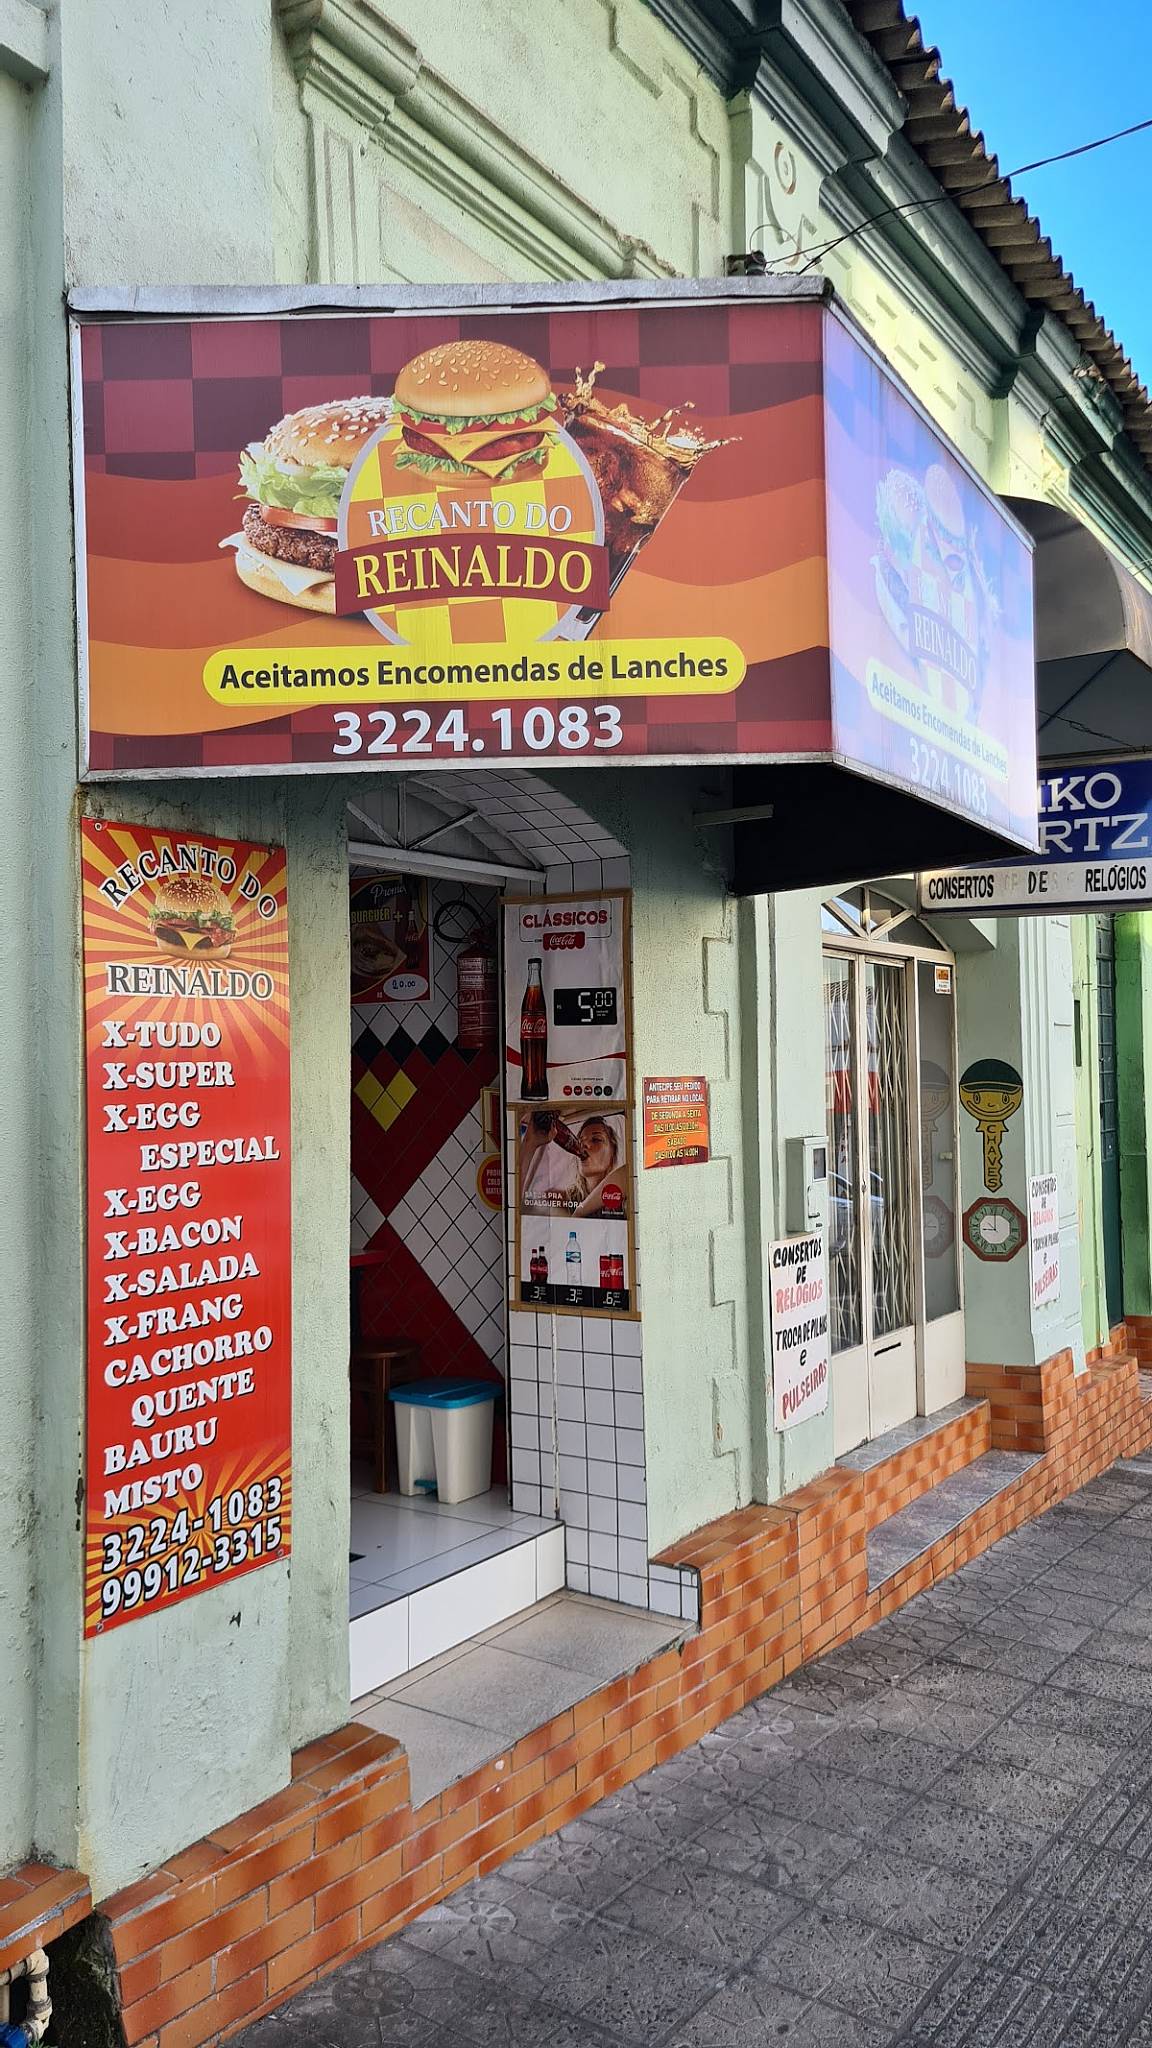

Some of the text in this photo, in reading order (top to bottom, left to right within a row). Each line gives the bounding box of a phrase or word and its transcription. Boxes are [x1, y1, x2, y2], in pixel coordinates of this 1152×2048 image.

[367, 499, 572, 537] RECANTO DO
[353, 545, 592, 598] REINALDO
[219, 653, 728, 690] Aceitamos Encomendas de Lanches
[913, 611, 977, 690] REINALDO
[332, 705, 624, 756] 3224.1083
[872, 672, 921, 721] Aceitamos
[922, 705, 972, 753] Encomendas
[910, 737, 988, 816] 3224.1083
[1038, 813, 1148, 855] RTZ
[99, 842, 278, 921] RECANTO DO
[928, 875, 994, 900] CONSERTOS
[1028, 871, 1048, 894] DE
[1085, 864, 1147, 892] RELÓGIOS
[522, 909, 608, 928] CLÁSSICOS
[106, 963, 274, 1000] REINALDO
[102, 1020, 222, 1048] X-TUDO
[102, 1061, 235, 1090] X-SUPER
[102, 1102, 201, 1132] X-EGG
[140, 1135, 280, 1172] ESPECIAL
[986, 1124, 998, 1188] CHAVES
[103, 1181, 202, 1218] X-EGG
[548, 1192, 563, 1200] PRA
[103, 1215, 243, 1261] X-BACON
[773, 1237, 822, 1268] CONSERTOS
[103, 1252, 260, 1303] X-SALADA
[796, 1264, 807, 1284] DE
[103, 1293, 244, 1346] X-FRANG
[775, 1324, 802, 1351] TROCA
[803, 1319, 811, 1342] DE
[103, 1325, 273, 1388] CACHORRO
[799, 1349, 807, 1366] e
[131, 1367, 255, 1428] QUENTE
[782, 1359, 827, 1420] PULSEIRAS
[103, 1417, 219, 1477] BAURU
[103, 1463, 203, 1520] MISTO
[101, 1476, 284, 1574] 3224-1083
[100, 1515, 283, 1619] 99912-3315
